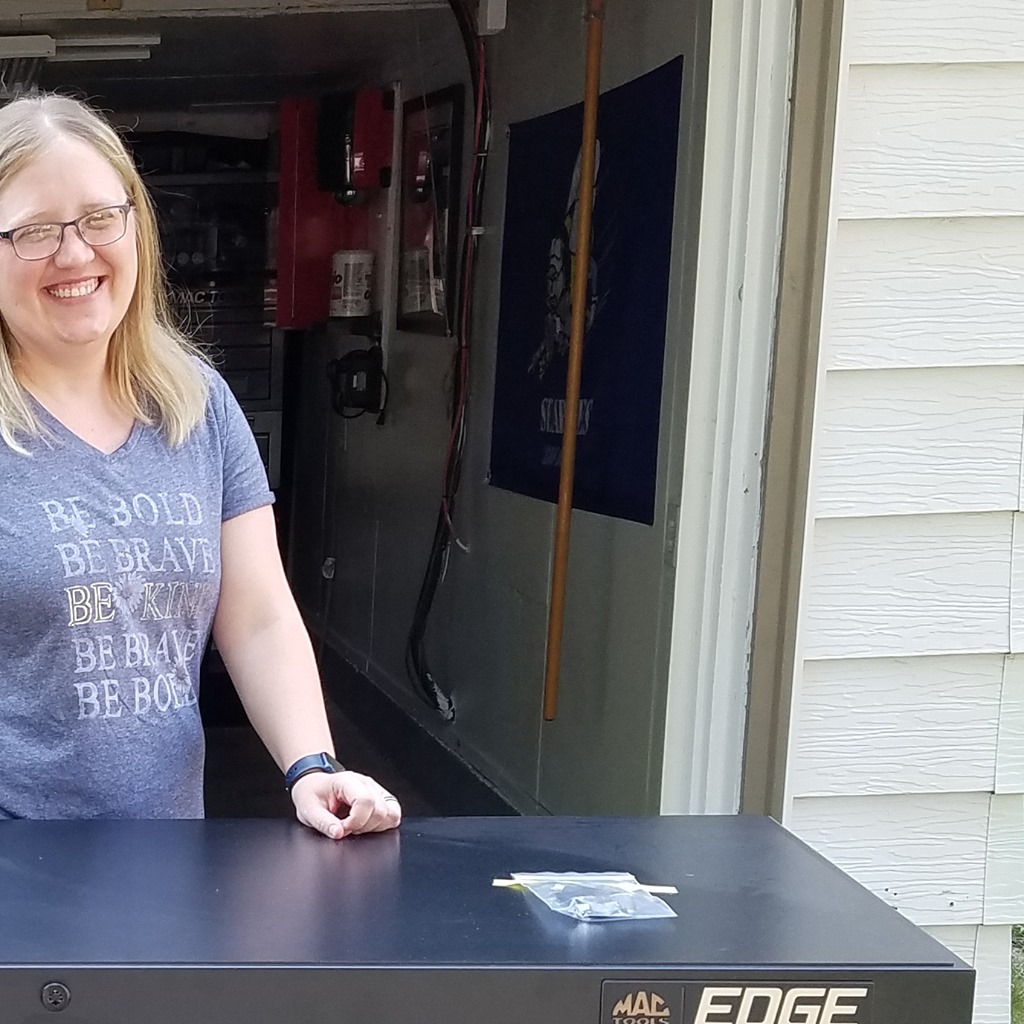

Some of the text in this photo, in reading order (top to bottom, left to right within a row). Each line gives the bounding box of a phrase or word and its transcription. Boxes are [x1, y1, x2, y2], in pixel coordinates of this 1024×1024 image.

[39, 493, 203, 535] BE BOLD
[54, 537, 216, 578] BE BRAVE
[65, 582, 116, 626] BE
[73, 629, 199, 673] BE BRAVE
[73, 679, 124, 720] BE
[612, 991, 670, 1016] MAC
